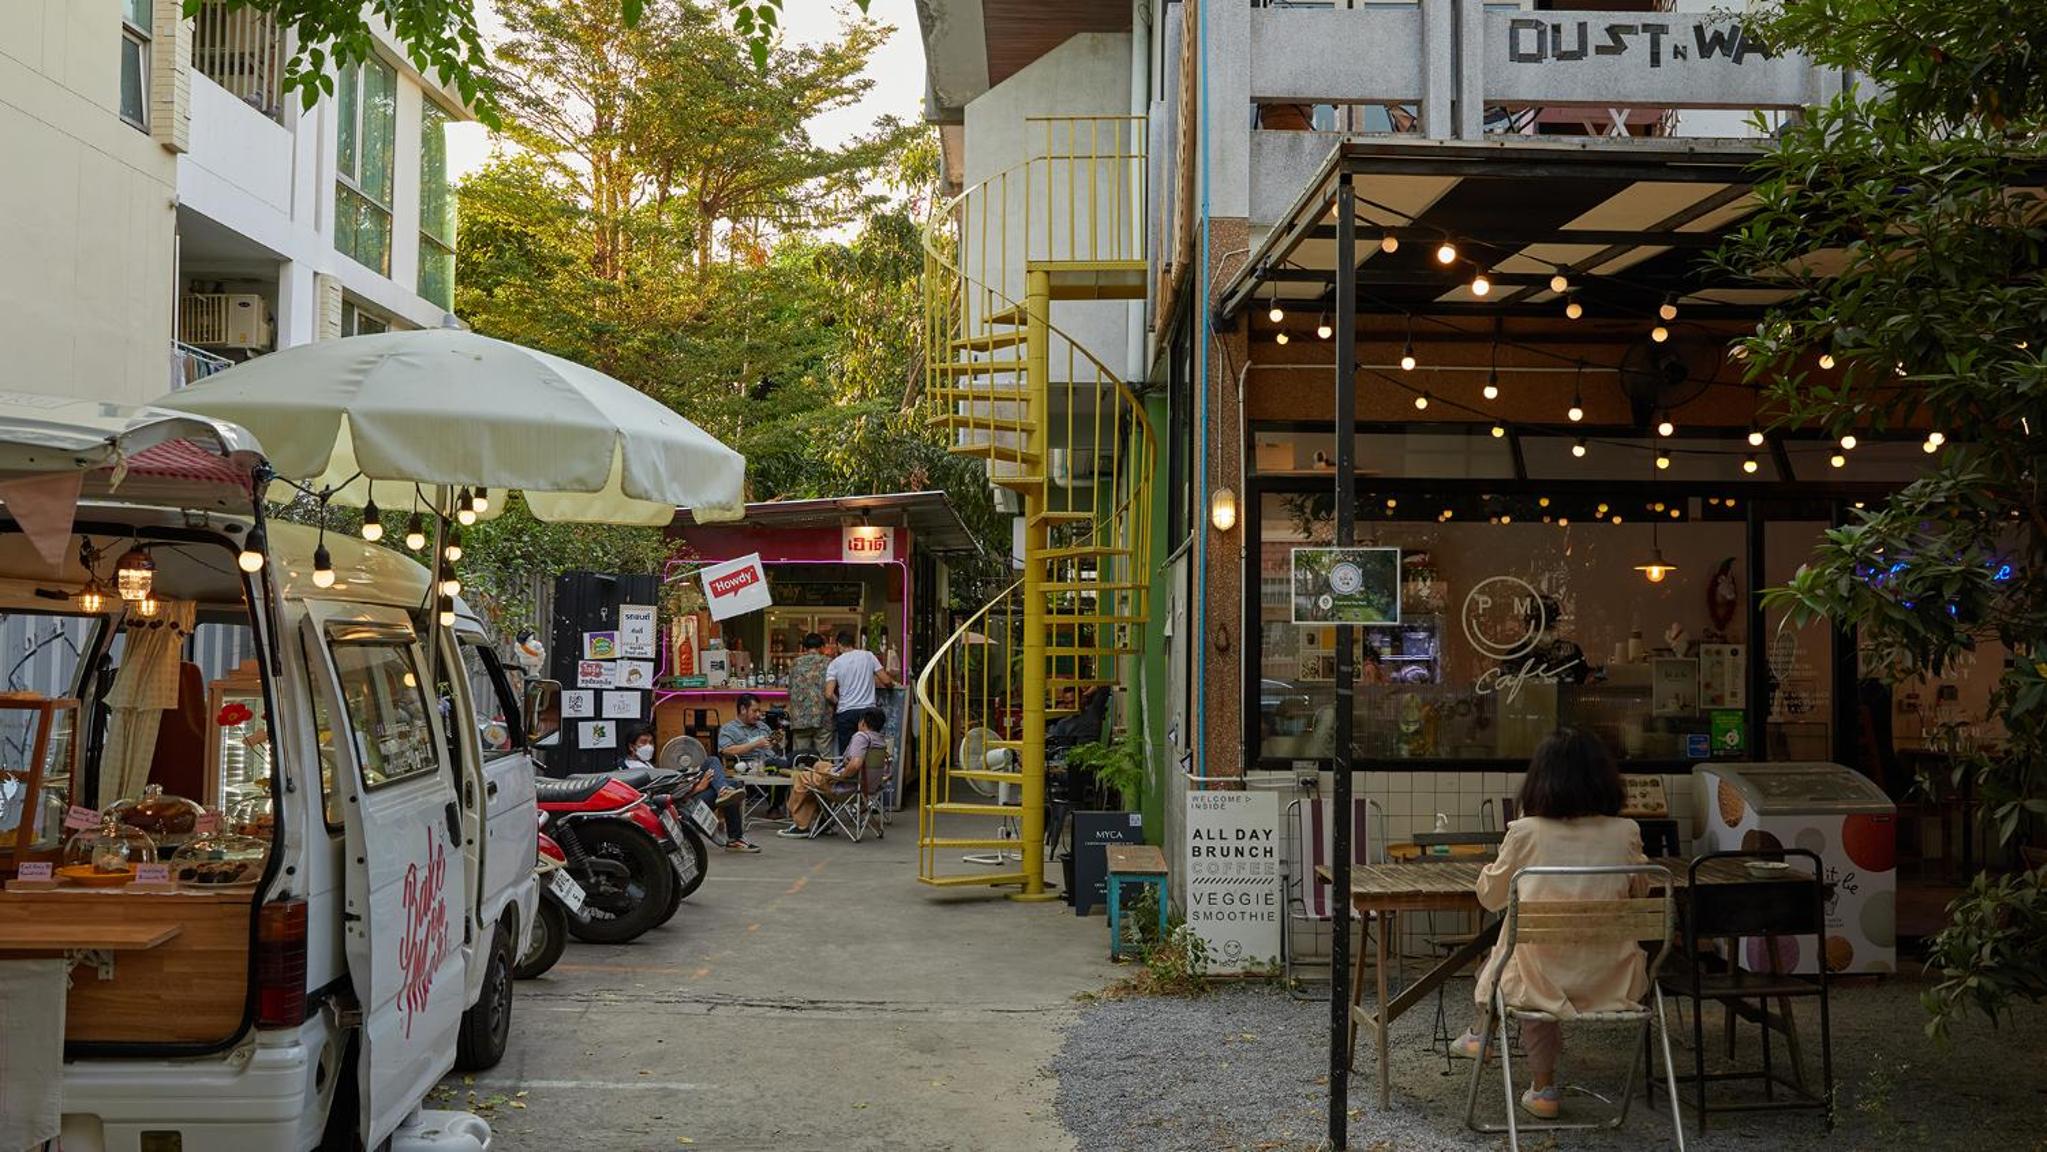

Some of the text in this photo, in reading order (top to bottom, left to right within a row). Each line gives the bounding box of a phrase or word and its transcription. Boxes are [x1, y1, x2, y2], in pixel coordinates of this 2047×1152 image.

[1191, 795, 1242, 803] WELCOME
[1096, 831, 1123, 839] MYCA
[1192, 828, 1273, 841] ALL DAY
[1191, 845, 1274, 858] BRUNCH
[1191, 862, 1275, 875] COFFEE
[1192, 892, 1276, 906] VEGGIE
[1192, 910, 1276, 922] SMOOTHIE
